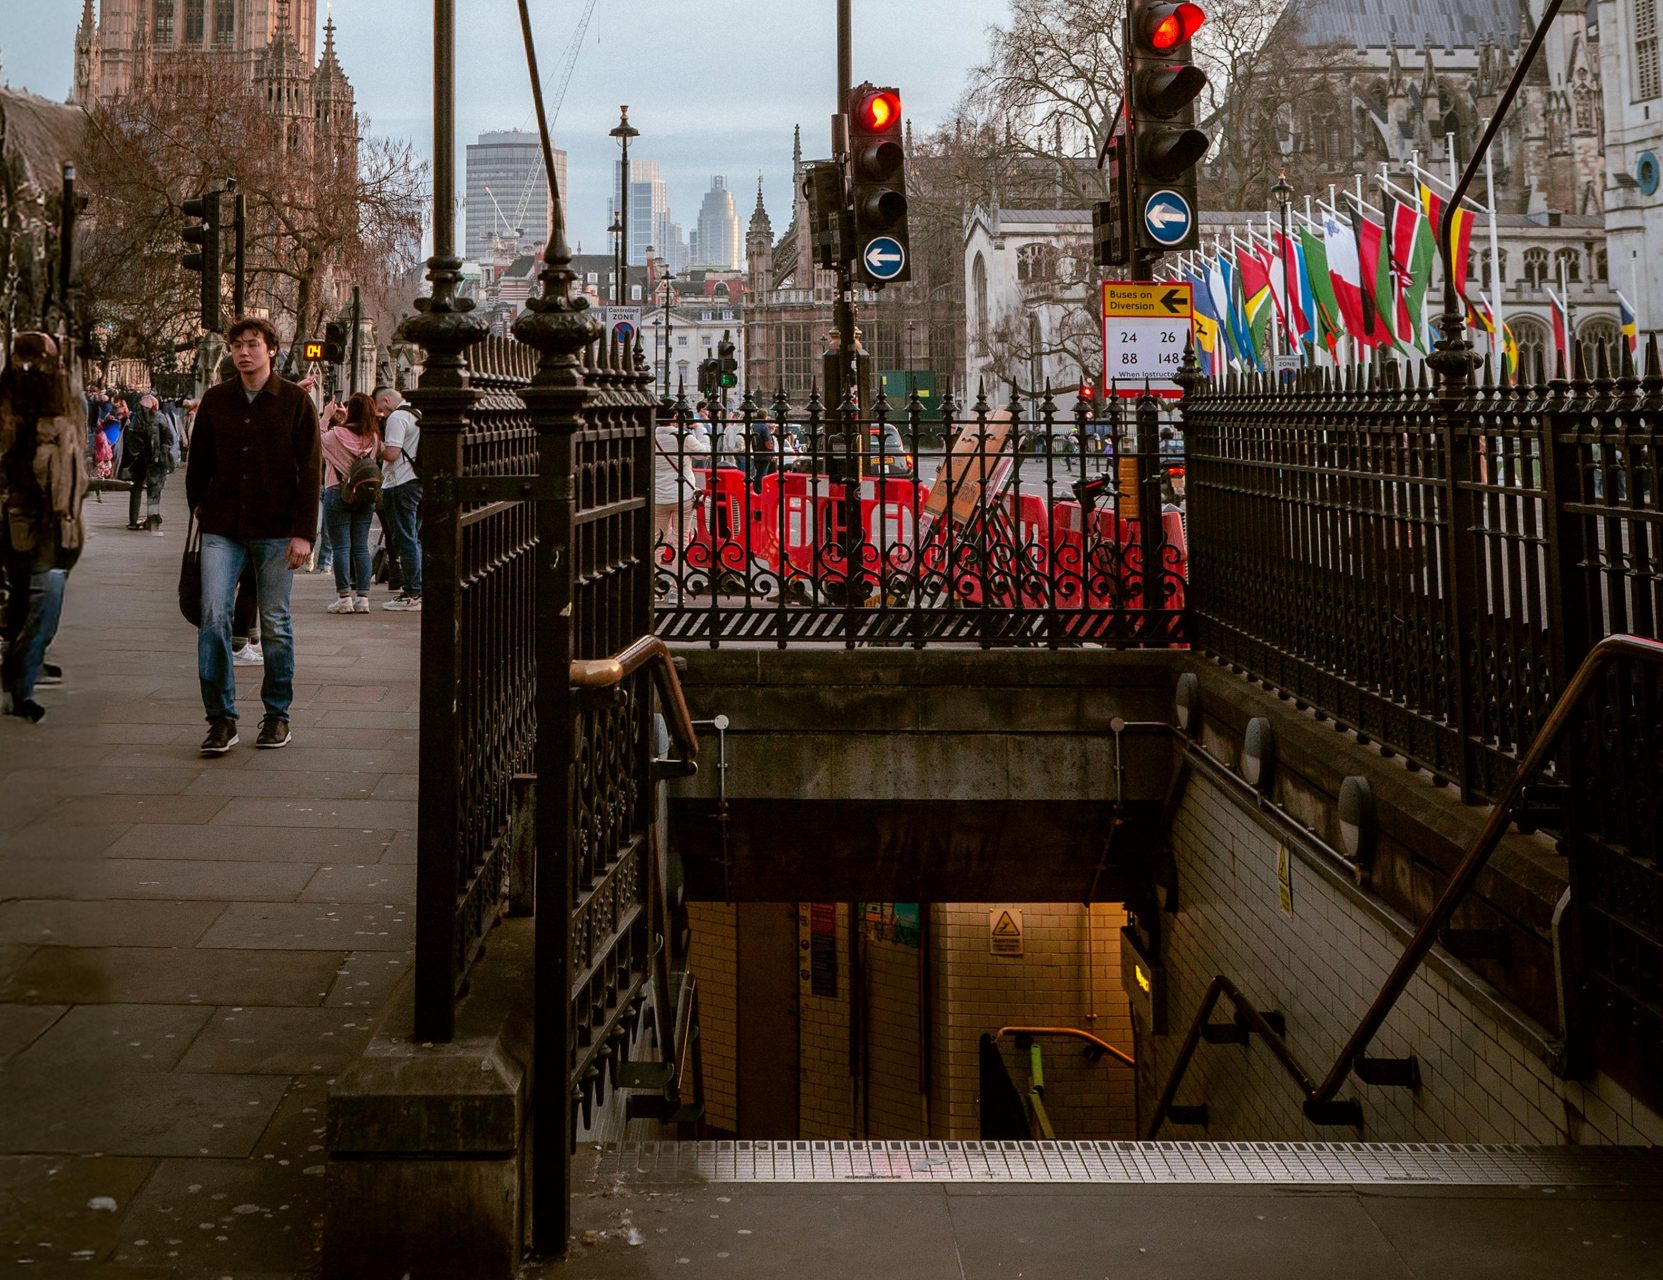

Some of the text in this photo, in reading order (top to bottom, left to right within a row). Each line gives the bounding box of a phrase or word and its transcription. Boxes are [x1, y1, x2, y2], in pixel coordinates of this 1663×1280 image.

[1110, 290, 1153, 299] Buses on
[1110, 301, 1155, 310] Diversion
[1120, 331, 1176, 343] 24 26
[307, 345, 321, 357] 04
[1121, 353, 1180, 365] 88 148
